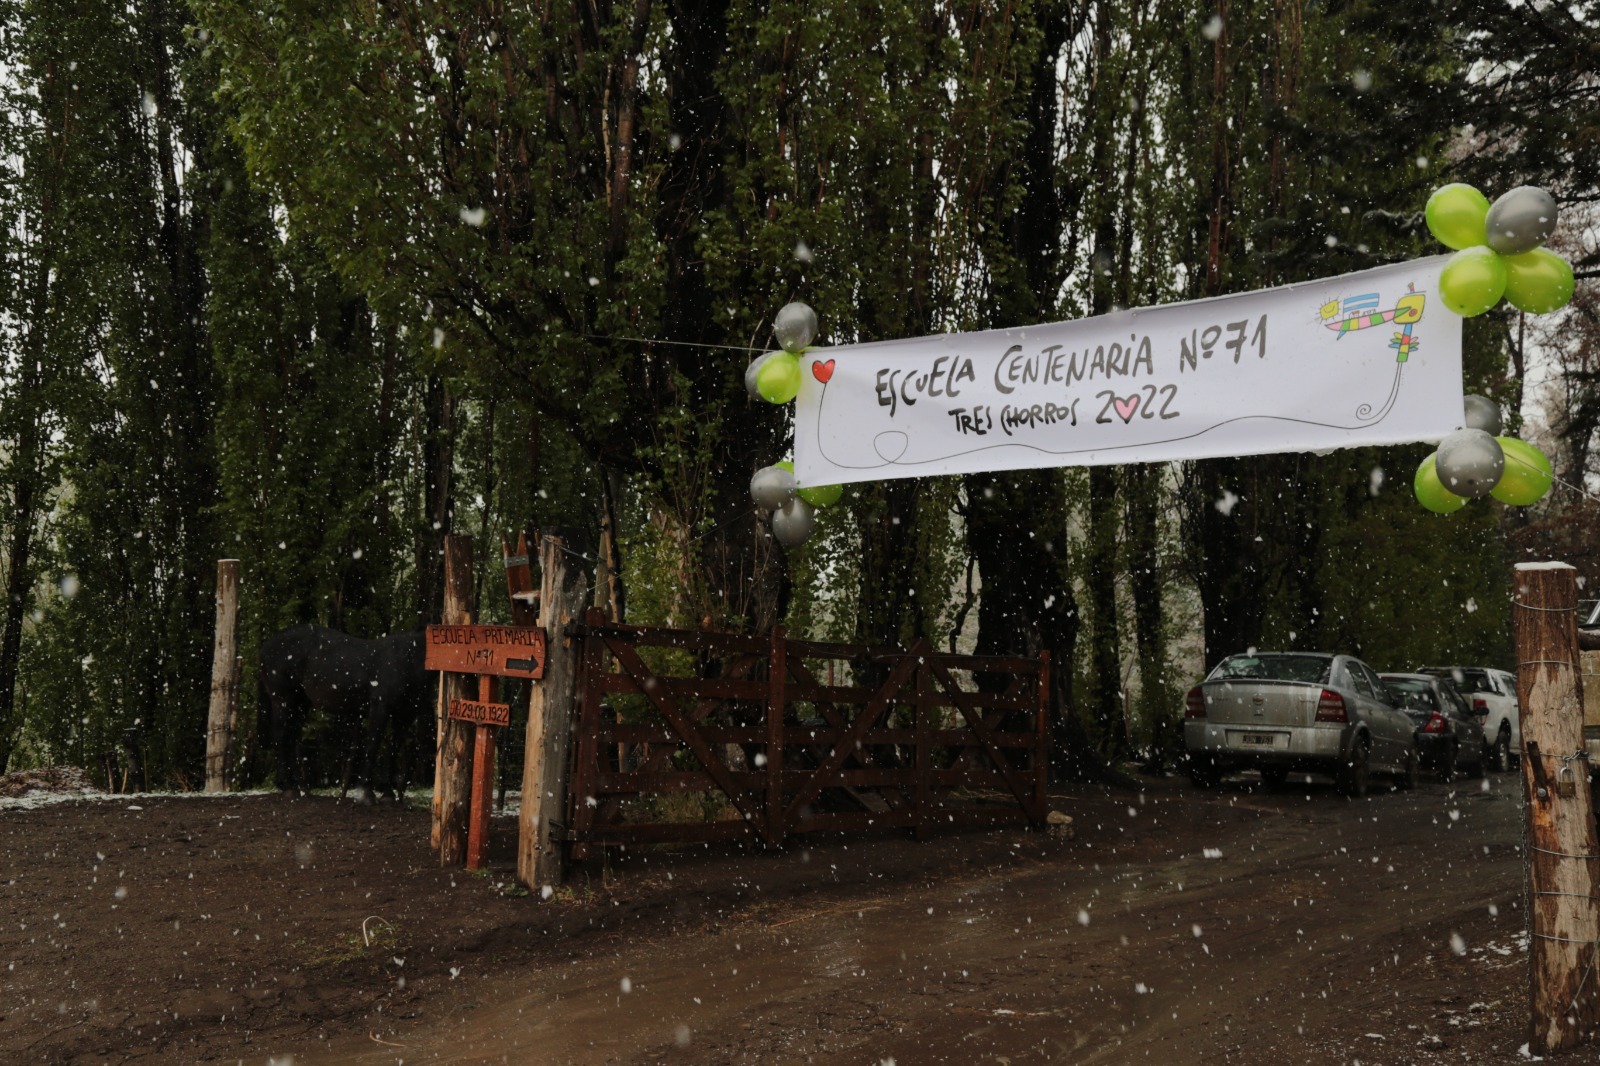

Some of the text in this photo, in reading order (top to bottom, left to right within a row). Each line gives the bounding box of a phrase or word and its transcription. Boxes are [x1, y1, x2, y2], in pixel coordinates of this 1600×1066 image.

[947, 404, 993, 436] TRES
[1000, 397, 1080, 436] CHORROS
[432, 629, 542, 646] ESCUELA PRIMARIA
